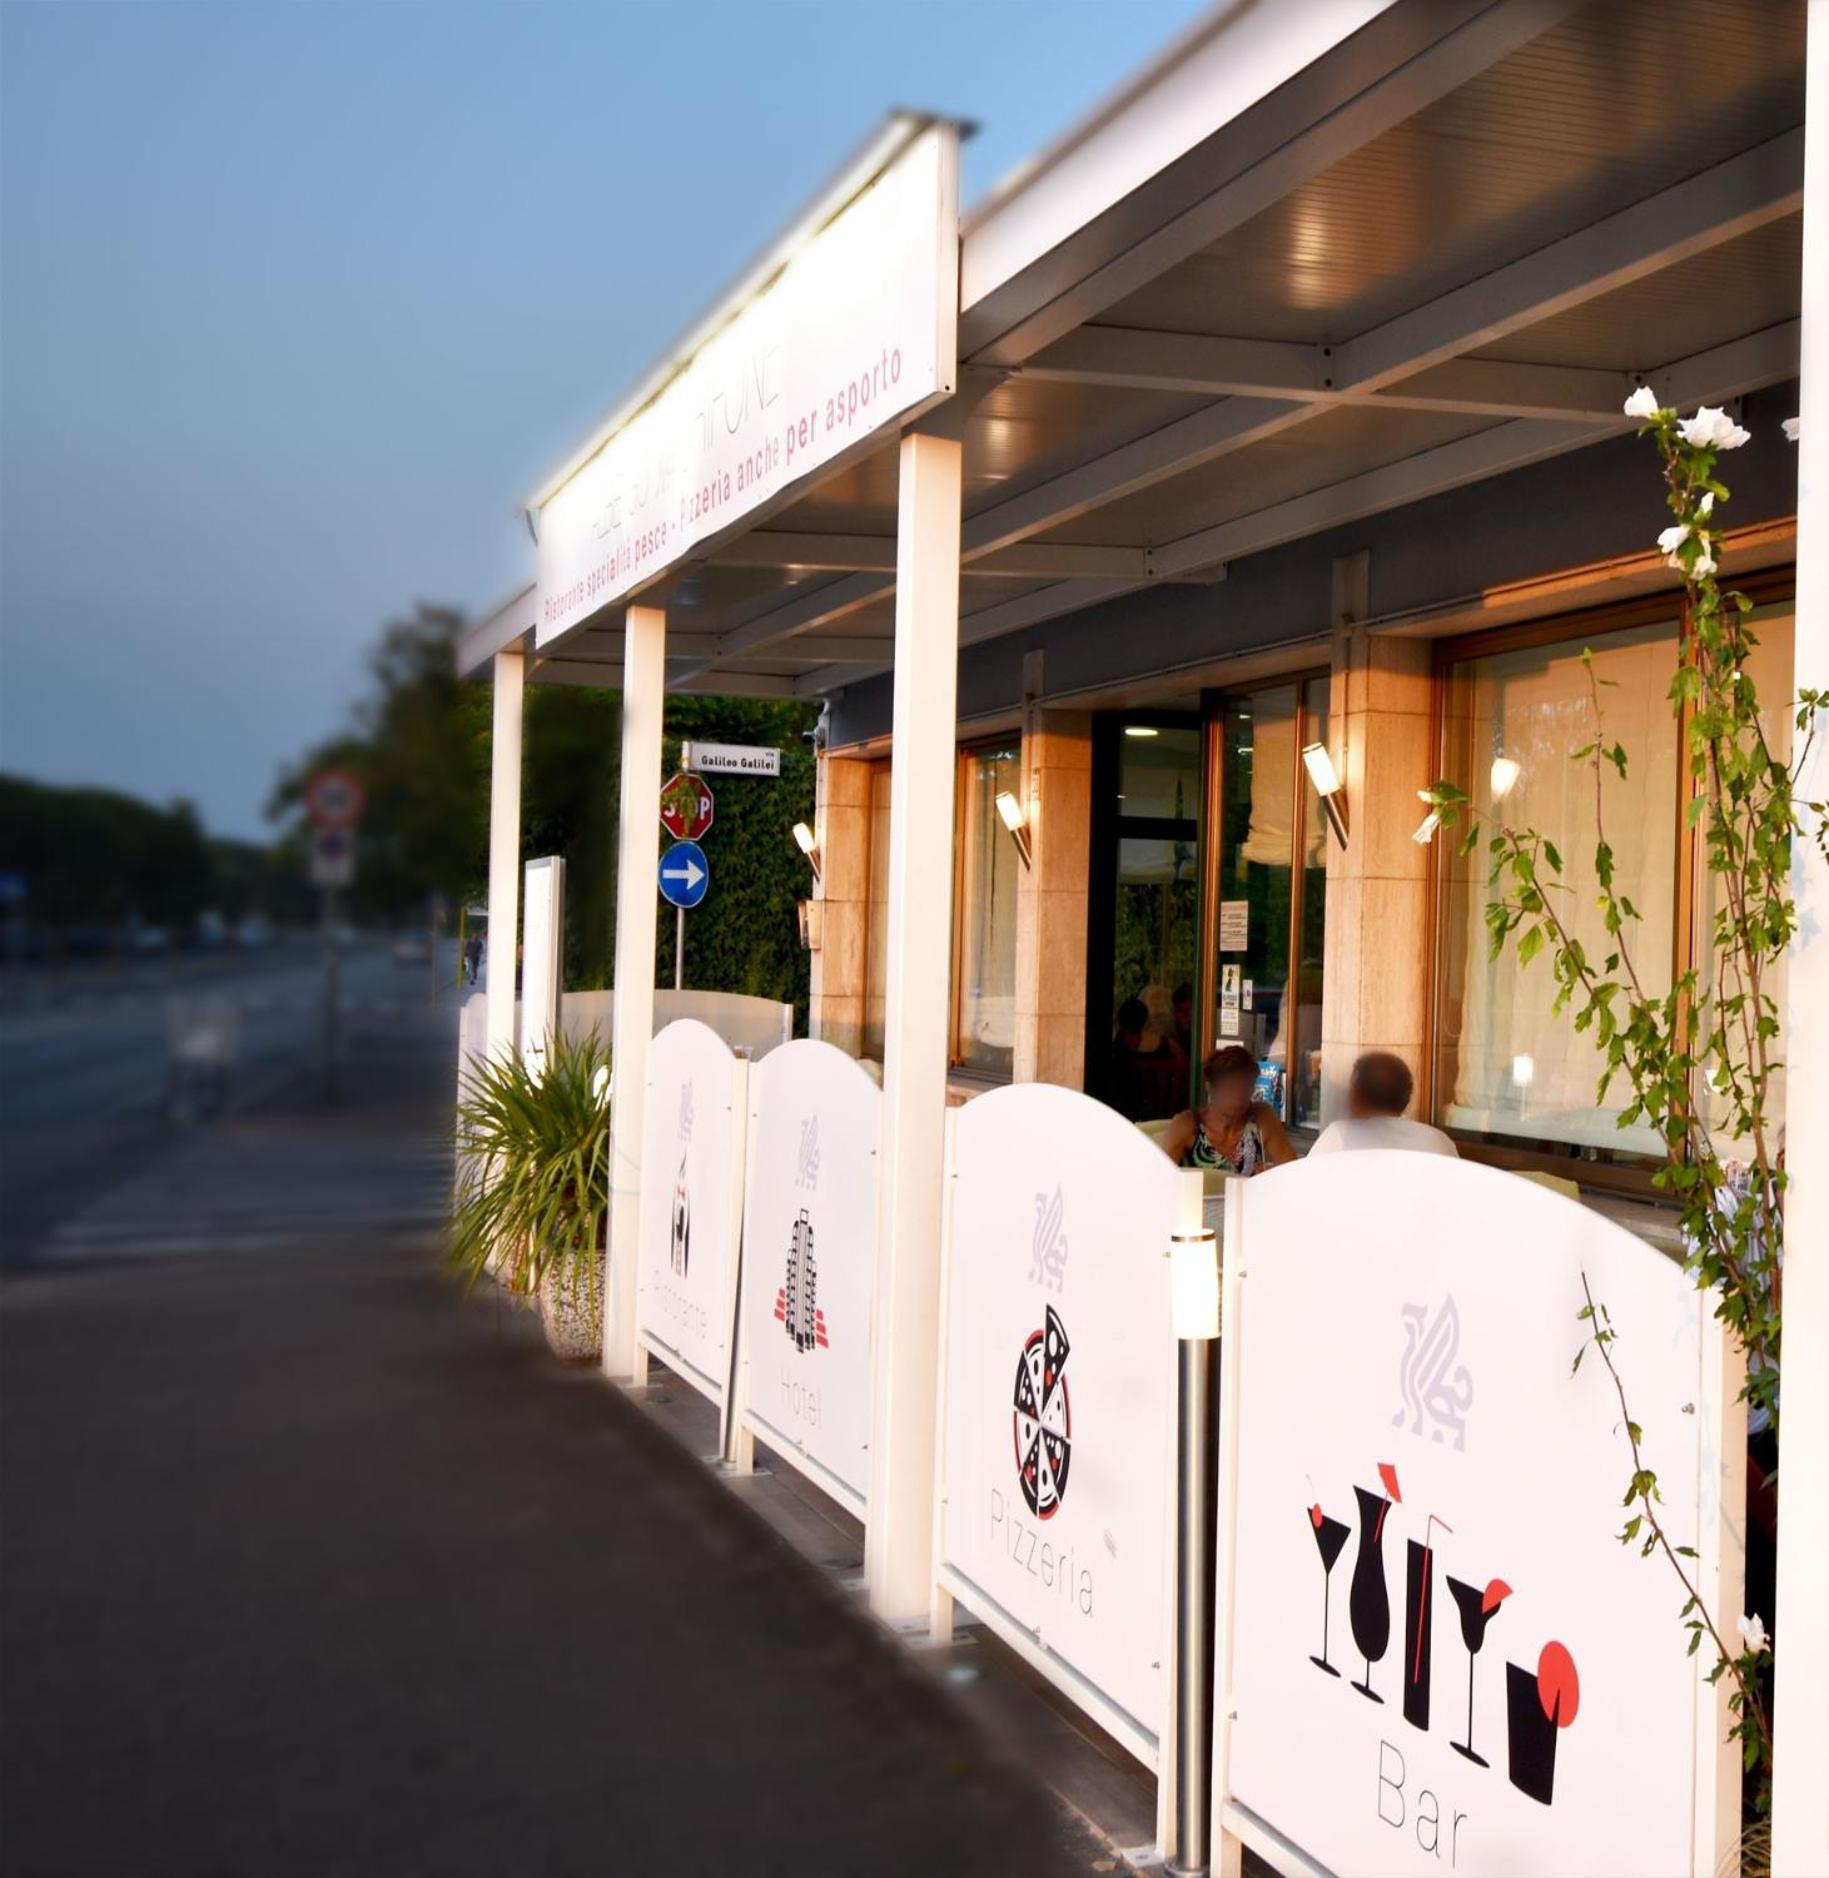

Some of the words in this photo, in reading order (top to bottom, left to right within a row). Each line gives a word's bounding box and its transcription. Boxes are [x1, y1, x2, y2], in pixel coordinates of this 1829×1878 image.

[635, 520, 667, 571] pesce
[737, 436, 780, 492] anche
[786, 412, 818, 466] per
[826, 347, 901, 428] asporto
[701, 755, 738, 767] Galileo
[741, 757, 775, 769] Galilei
[991, 1487, 1094, 1618] Pizzeria
[1378, 1739, 1468, 1868] Bar
